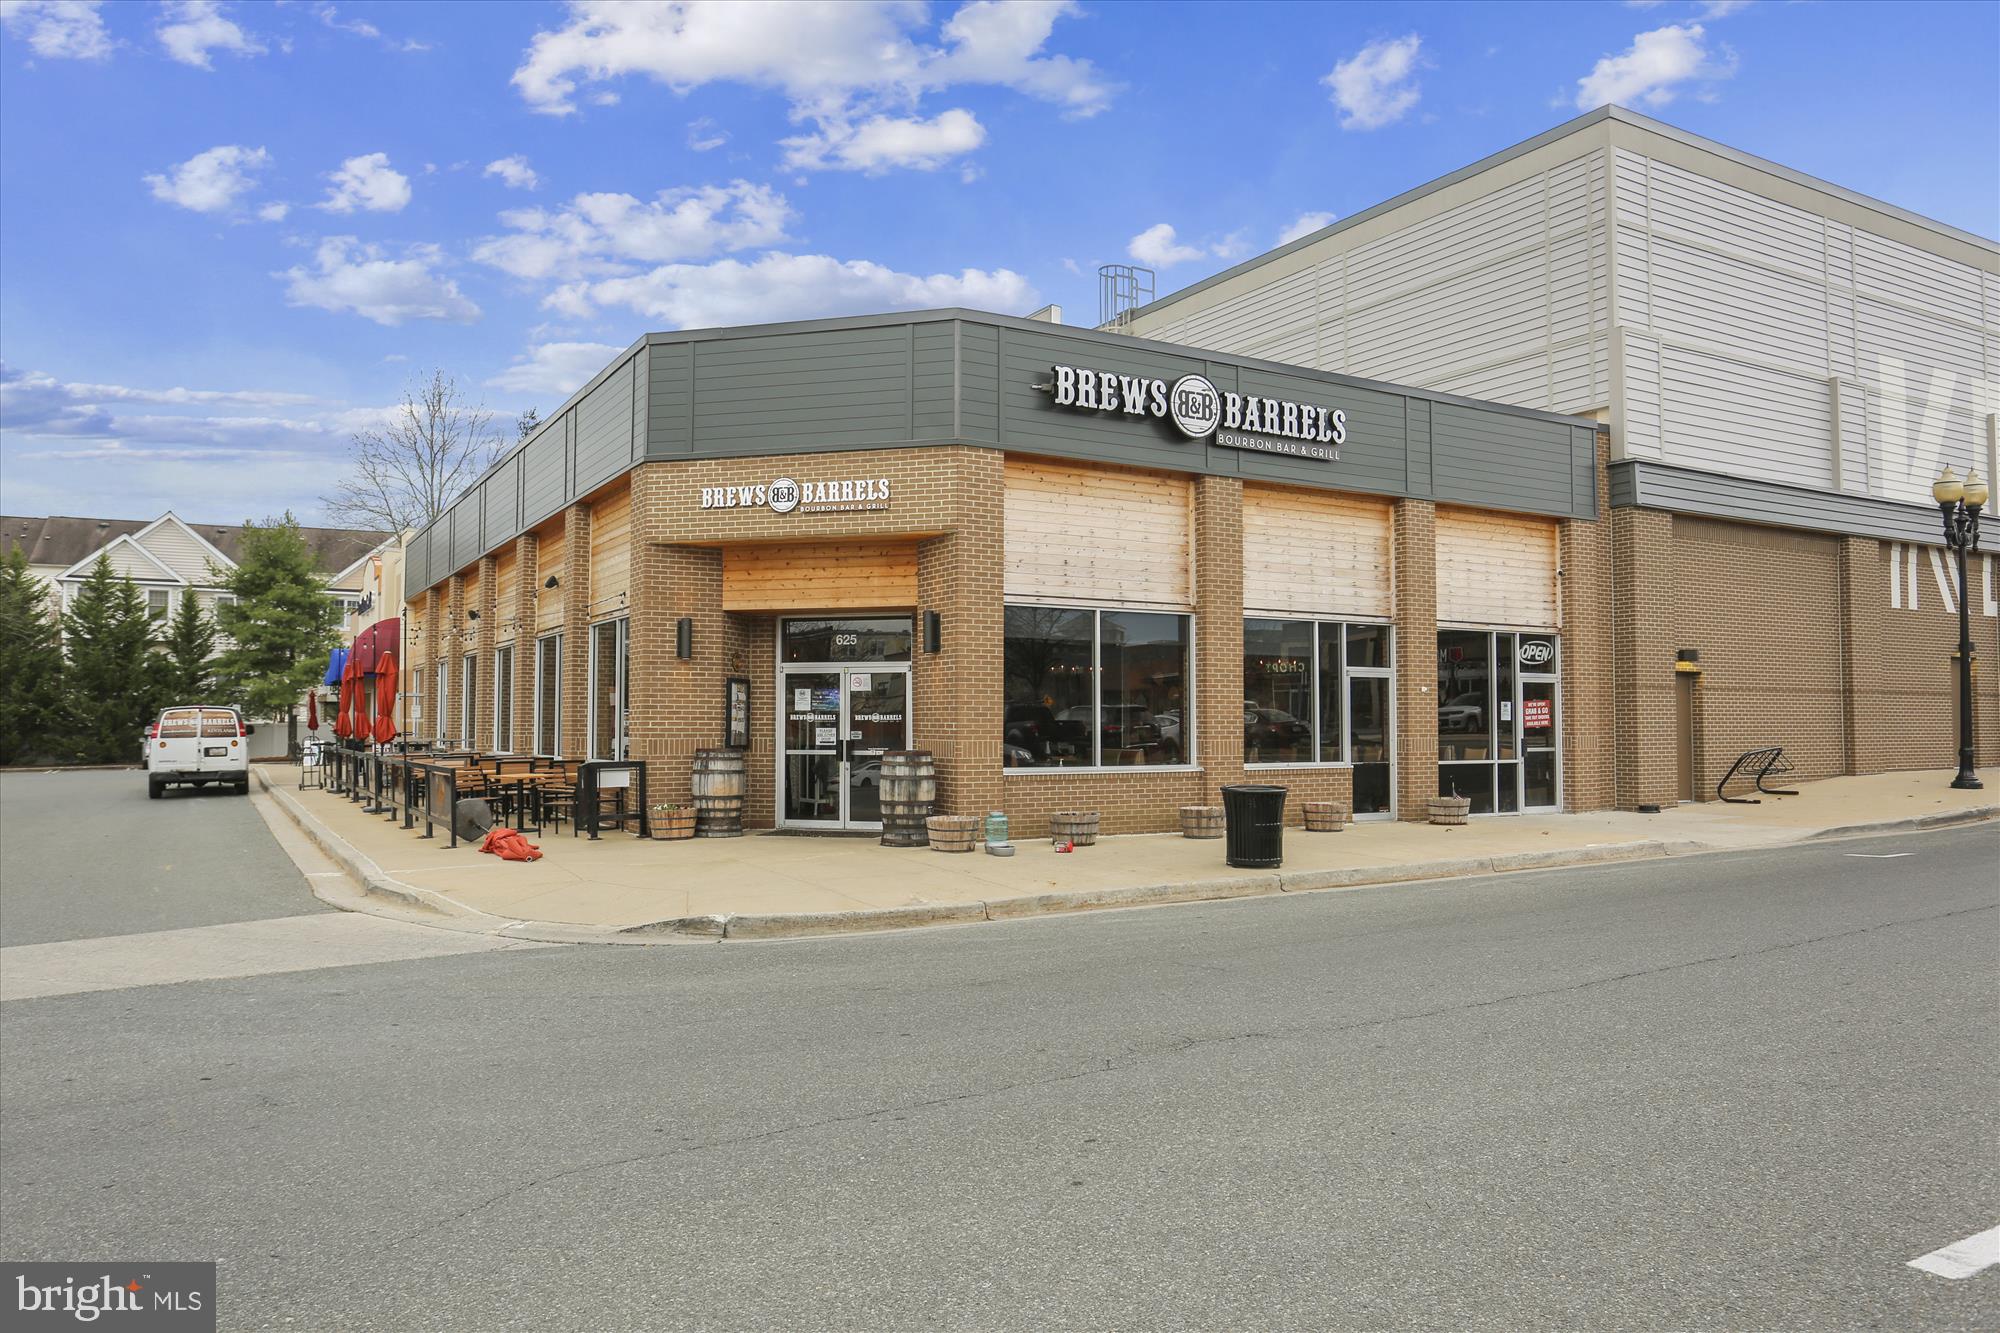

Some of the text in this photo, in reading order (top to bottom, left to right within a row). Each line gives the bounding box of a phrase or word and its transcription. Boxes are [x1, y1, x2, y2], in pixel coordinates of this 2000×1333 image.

[1055, 365, 1168, 418] BREWS
[1223, 391, 1347, 445] BARRELS
[1217, 433, 1341, 460] BOURBON BAR & GRILL
[700, 484, 766, 509] BREWS
[801, 478, 890, 503] BARRELS
[800, 504, 837, 513] BOURBON
[840, 503, 855, 512] BAR
[866, 502, 889, 510] GRILL
[835, 634, 857, 646] 625
[1521, 644, 1550, 662] OPEN
[1525, 707, 1537, 715] GRAB
[1541, 706, 1549, 714] GO
[163, 718, 188, 726] BREWS
[202, 718, 235, 726] BARRELS
